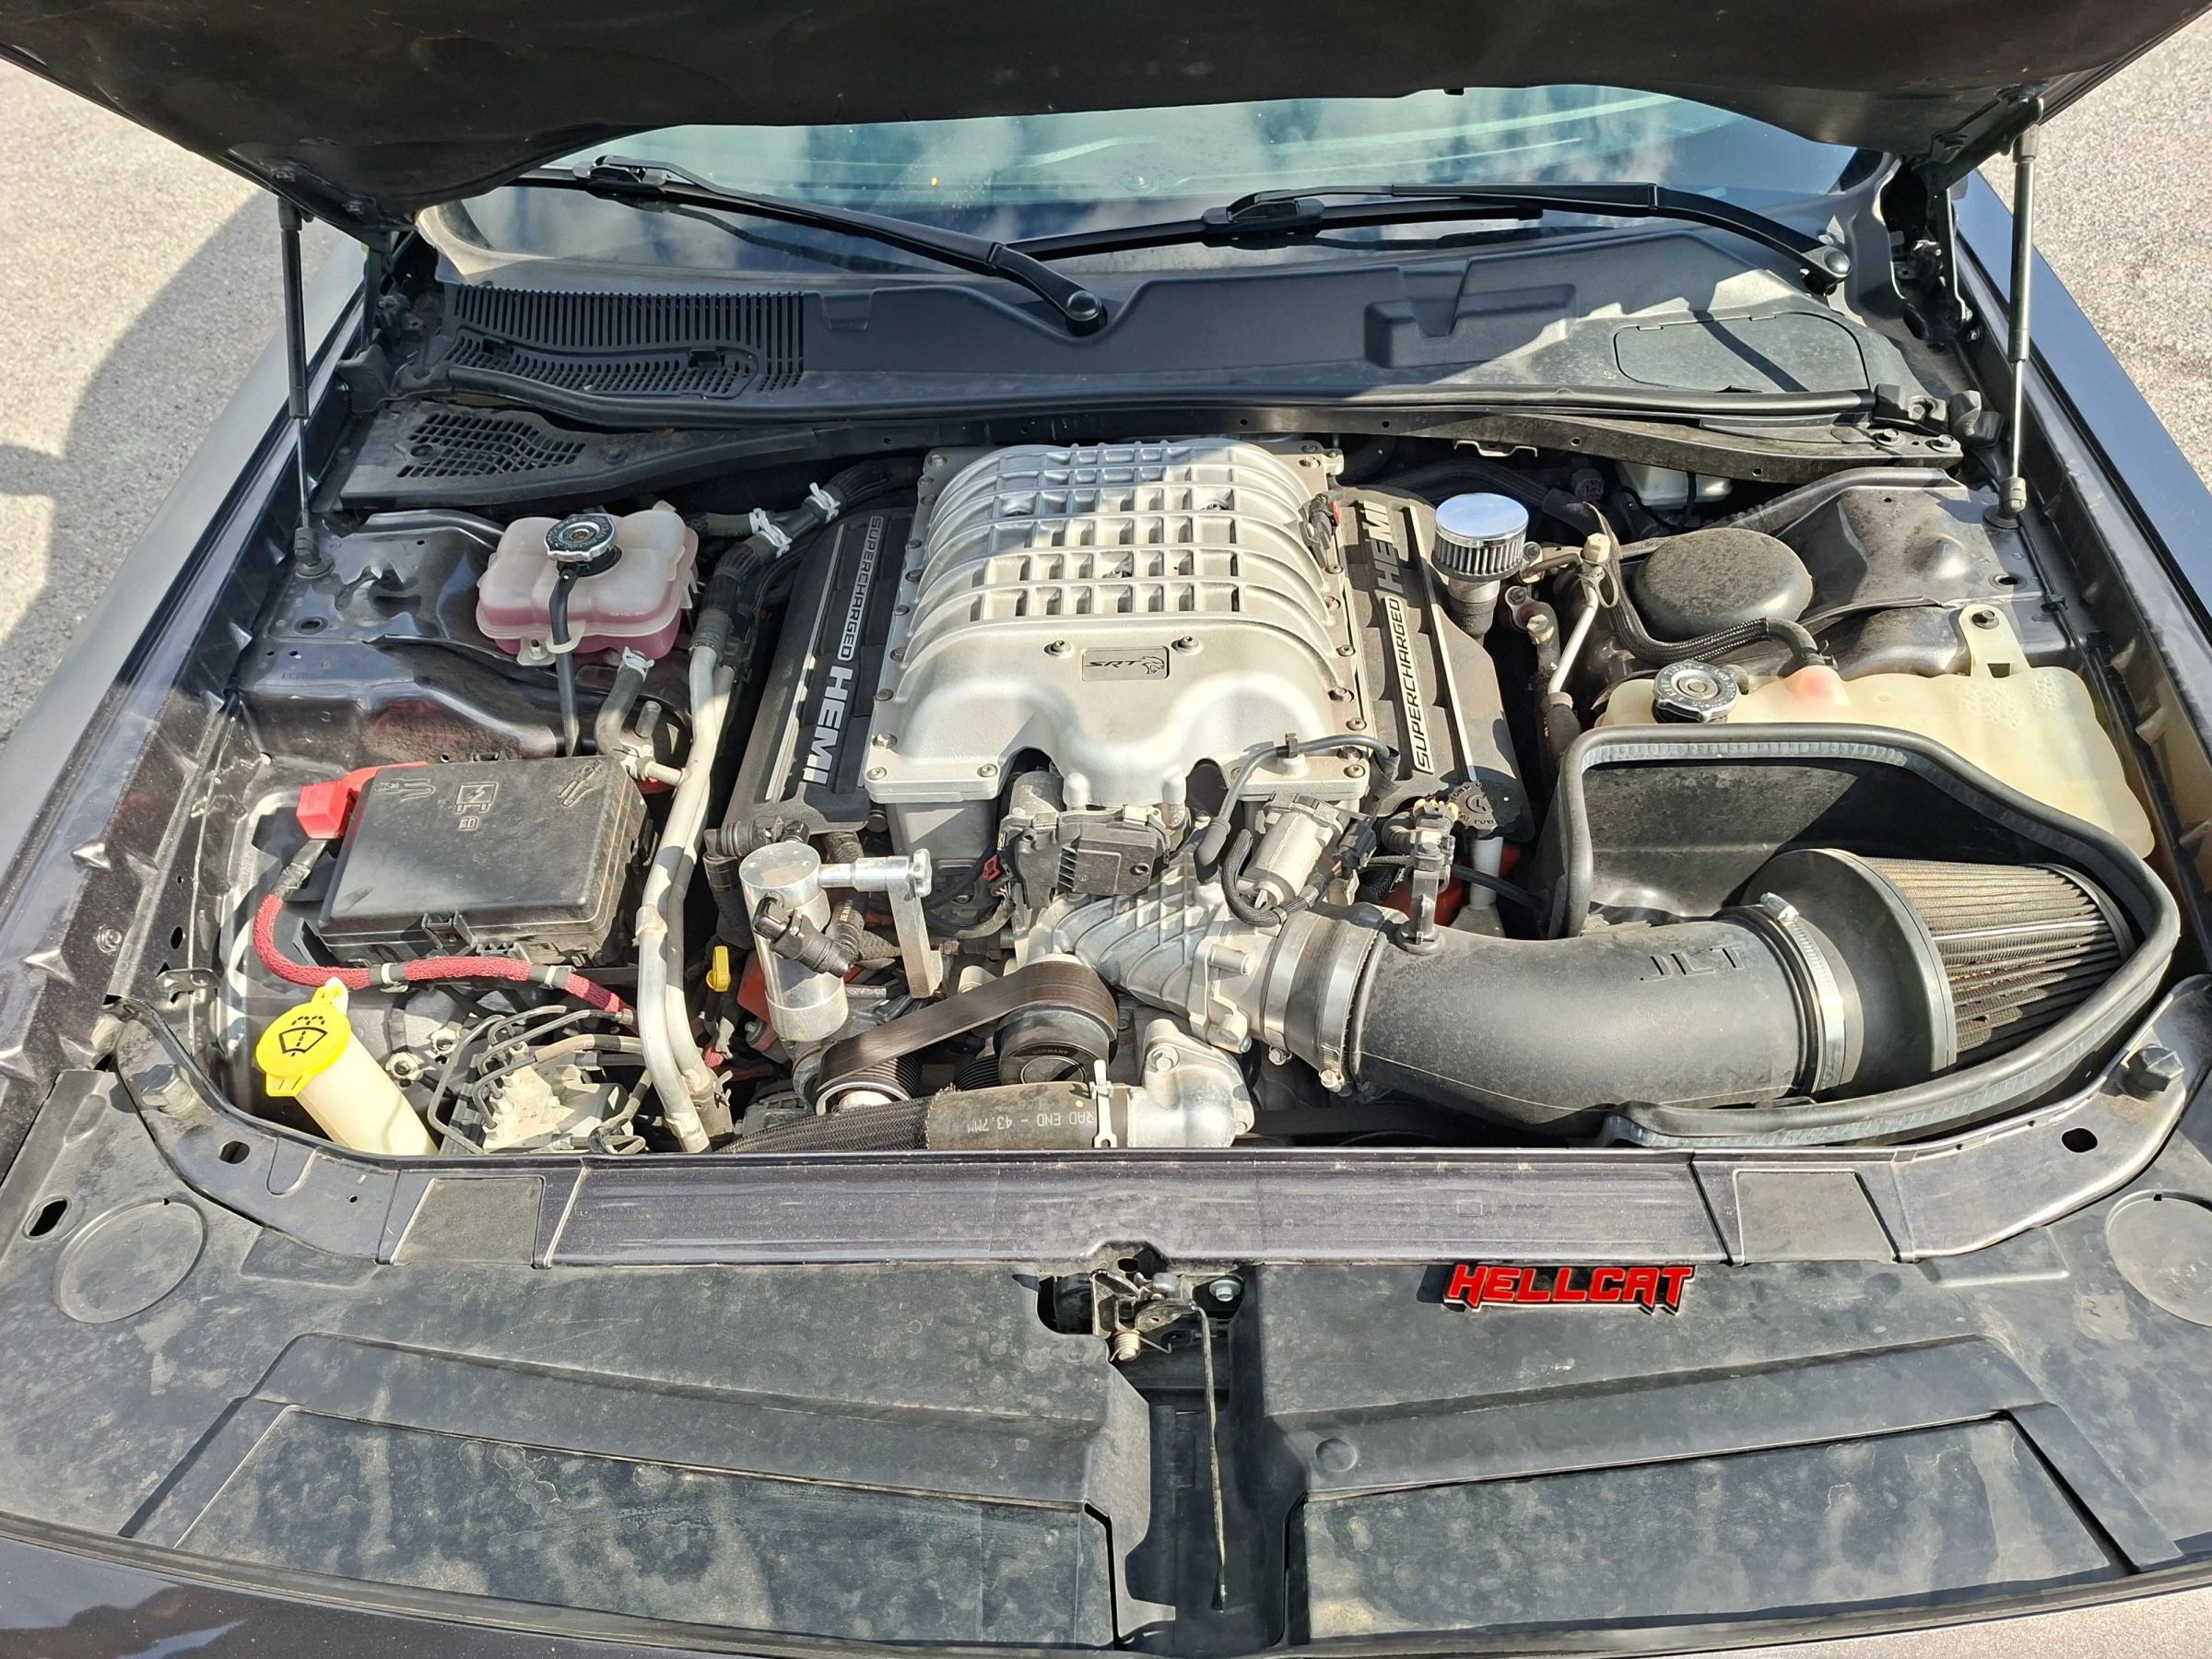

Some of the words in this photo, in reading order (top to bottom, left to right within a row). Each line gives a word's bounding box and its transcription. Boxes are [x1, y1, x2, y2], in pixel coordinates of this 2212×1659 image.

[1363, 500, 1404, 594] HEMI
[840, 516, 882, 660] SUPERCHARGED
[1084, 660, 1142, 669] SRT
[1388, 597, 1431, 771] SUPERCHARGED
[803, 665, 853, 784] HEMI
[1639, 942, 1746, 982] JLT
[967, 1115, 1013, 1134] 43.7MM
[1036, 1112, 1062, 1126] END
[1069, 1110, 1097, 1125] RAD
[1446, 1264, 1694, 1309] HELLCAT
